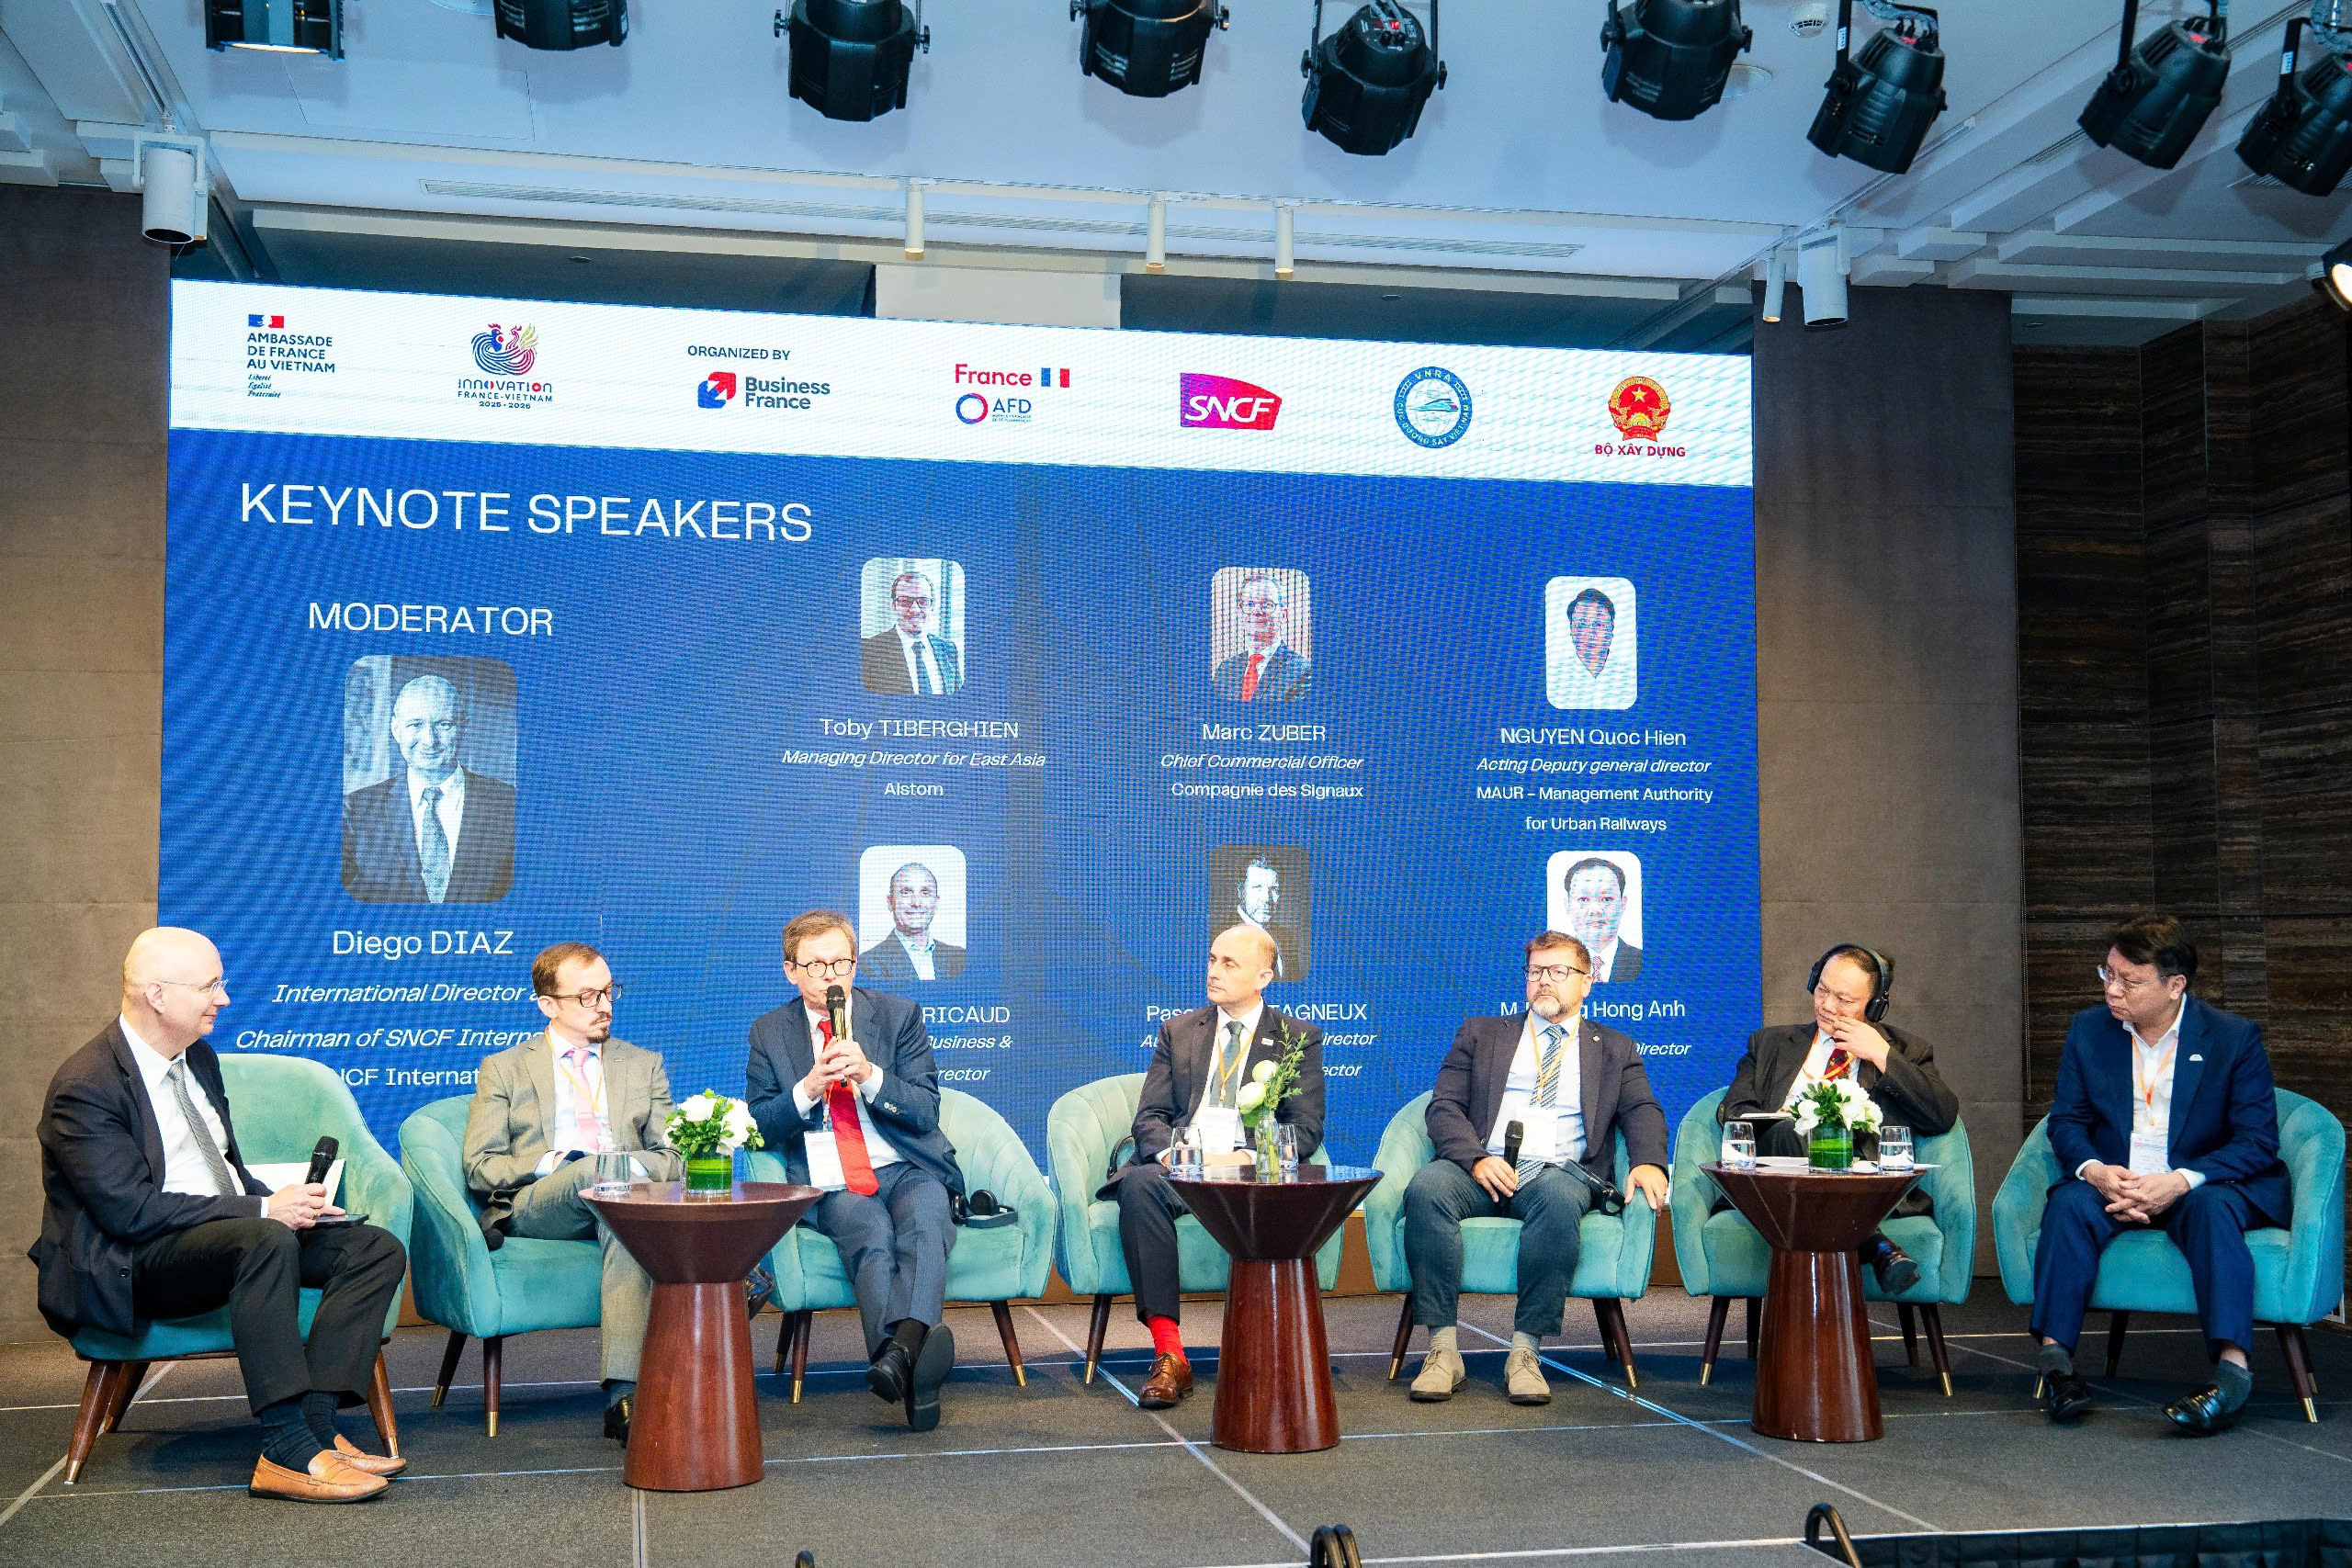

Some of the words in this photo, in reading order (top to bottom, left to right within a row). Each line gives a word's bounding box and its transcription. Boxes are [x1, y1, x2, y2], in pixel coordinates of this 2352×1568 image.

[247, 333, 333, 346] AMBASSADE
[247, 345, 266, 355] DE
[269, 347, 325, 359] FRANCE
[687, 345, 769, 359] ORGANIZED
[773, 350, 791, 360] BY
[246, 359, 266, 368] AU
[270, 360, 335, 373] VIETNAM
[955, 364, 1033, 386] France
[1414, 369, 1452, 382] VNRA
[745, 377, 831, 395] Business
[458, 391, 552, 401] FRANCE-VIETNAM
[745, 392, 811, 409] France
[992, 398, 1032, 413] AFD
[1184, 395, 1275, 423] SNCF
[1594, 442, 1613, 457] BỘ
[1617, 443, 1643, 456] XÂY
[1646, 446, 1686, 458] DỰNG
[242, 482, 511, 532] KEYNOTE
[527, 493, 812, 542] SPEAKERS
[309, 602, 552, 636] MODERATOR
[819, 717, 874, 740] Toby
[877, 719, 1019, 739] TIBERGHIEN
[1203, 723, 1252, 740] Marc
[1258, 724, 1326, 741] ZUBER
[1501, 728, 1584, 745] NGUYEN
[1589, 729, 1640, 745] Quoc
[1645, 729, 1686, 746] Hien
[782, 750, 866, 768] Managing
[868, 750, 941, 765] Director
[942, 751, 968, 765] for
[969, 752, 1009, 766] East
[1008, 752, 1046, 767] Asia
[1160, 753, 1207, 768] Chief
[1207, 754, 1306, 769] Commercial
[1307, 755, 1364, 769] Officer
[1476, 758, 1527, 774] Acting
[1531, 758, 1589, 773] Deputy
[1589, 760, 1648, 773] general
[1650, 760, 1713, 773] director
[884, 782, 944, 796] Alstom
[1170, 783, 1264, 799] Compagnie
[1267, 783, 1297, 796] des
[1300, 784, 1363, 800] Signaux
[1476, 786, 1523, 799] MAUR
[1539, 787, 1639, 803] Management
[1642, 787, 1713, 804] Authority
[1525, 817, 1548, 829] for
[1551, 817, 1597, 830] Urban
[1600, 817, 1667, 832] Railways
[333, 931, 422, 960] Diego
[431, 931, 514, 954] DIAZ
[273, 984, 427, 1002] International
[431, 984, 526, 1002] Director
[921, 1004, 1012, 1024] RICAUD
[1147, 1005, 1194, 1021] Pas
[1593, 1000, 1644, 1021] Hong
[1648, 1000, 1686, 1018] Anh
[236, 1030, 353, 1050] Chairman
[356, 1028, 383, 1047] of
[385, 1029, 455, 1046] SNCF
[458, 1028, 545, 1046] Intern
[999, 1034, 1013, 1049] &
[1322, 1032, 1377, 1046] irector
[341, 1067, 379, 1086] CF
[385, 1067, 481, 1086] Internat
[938, 1068, 990, 1081] rector
[1322, 1065, 1363, 1077] ector
